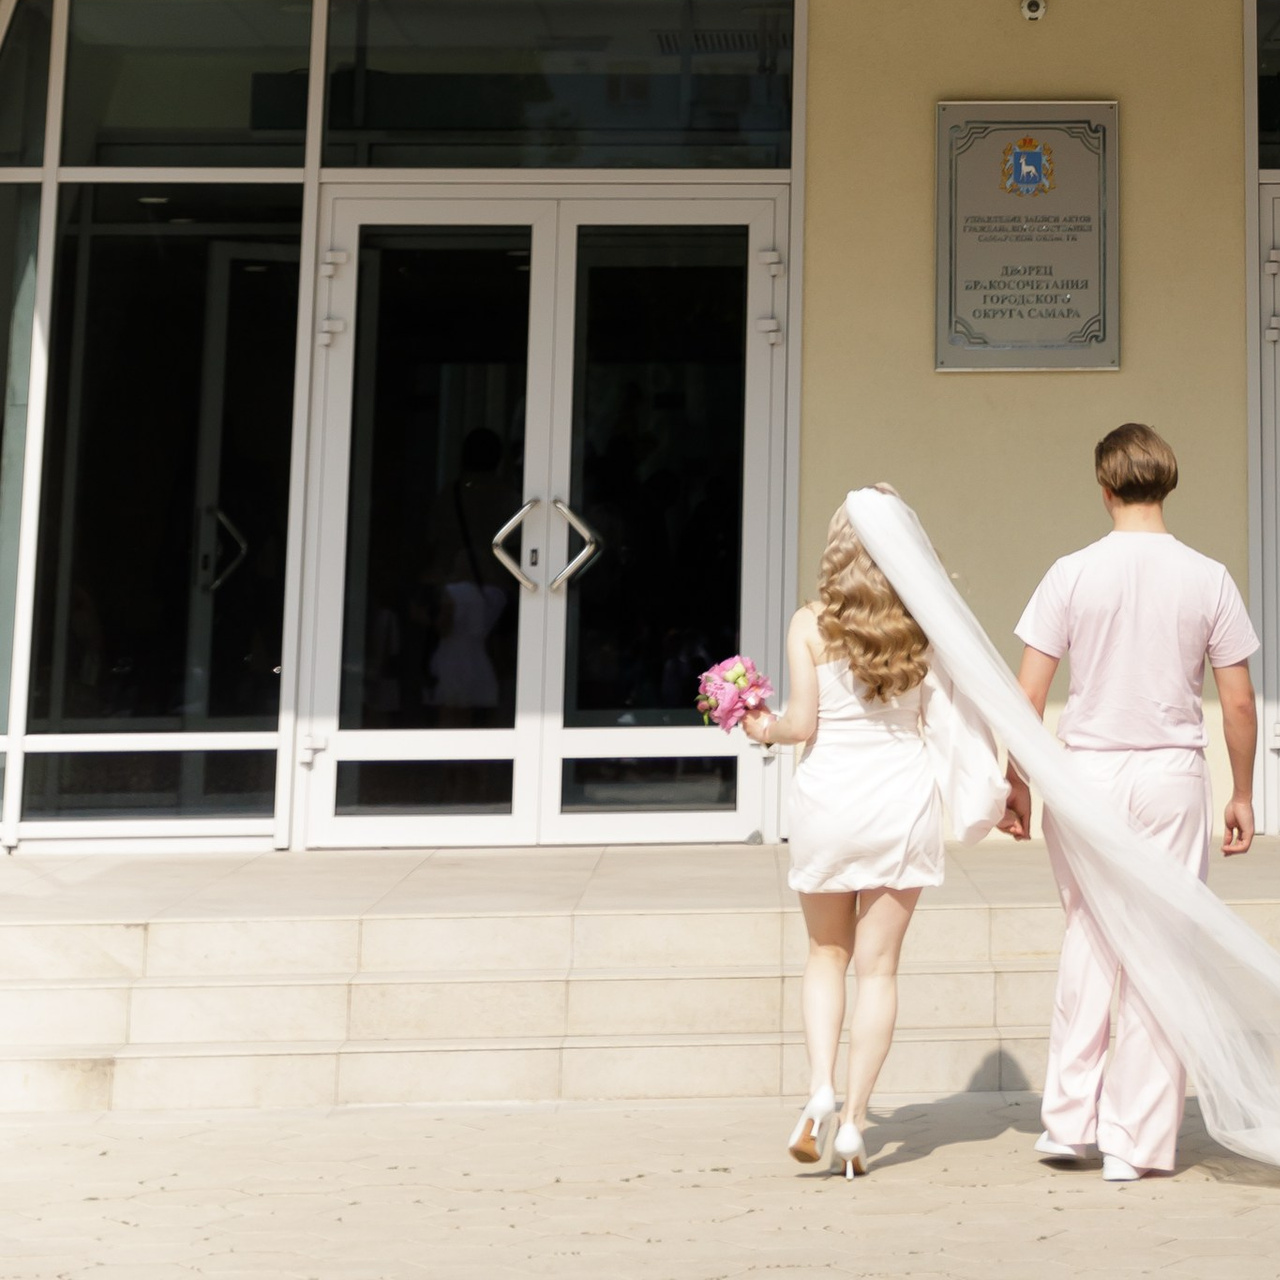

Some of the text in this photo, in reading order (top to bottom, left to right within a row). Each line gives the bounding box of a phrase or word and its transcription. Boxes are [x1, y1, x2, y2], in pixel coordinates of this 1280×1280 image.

[1000, 265, 1054, 277] ДВОРЕЦ
[982, 294, 1071, 306] ГОРОДСКОГО
[972, 308, 1081, 319] ОКРУГА САМАРА
